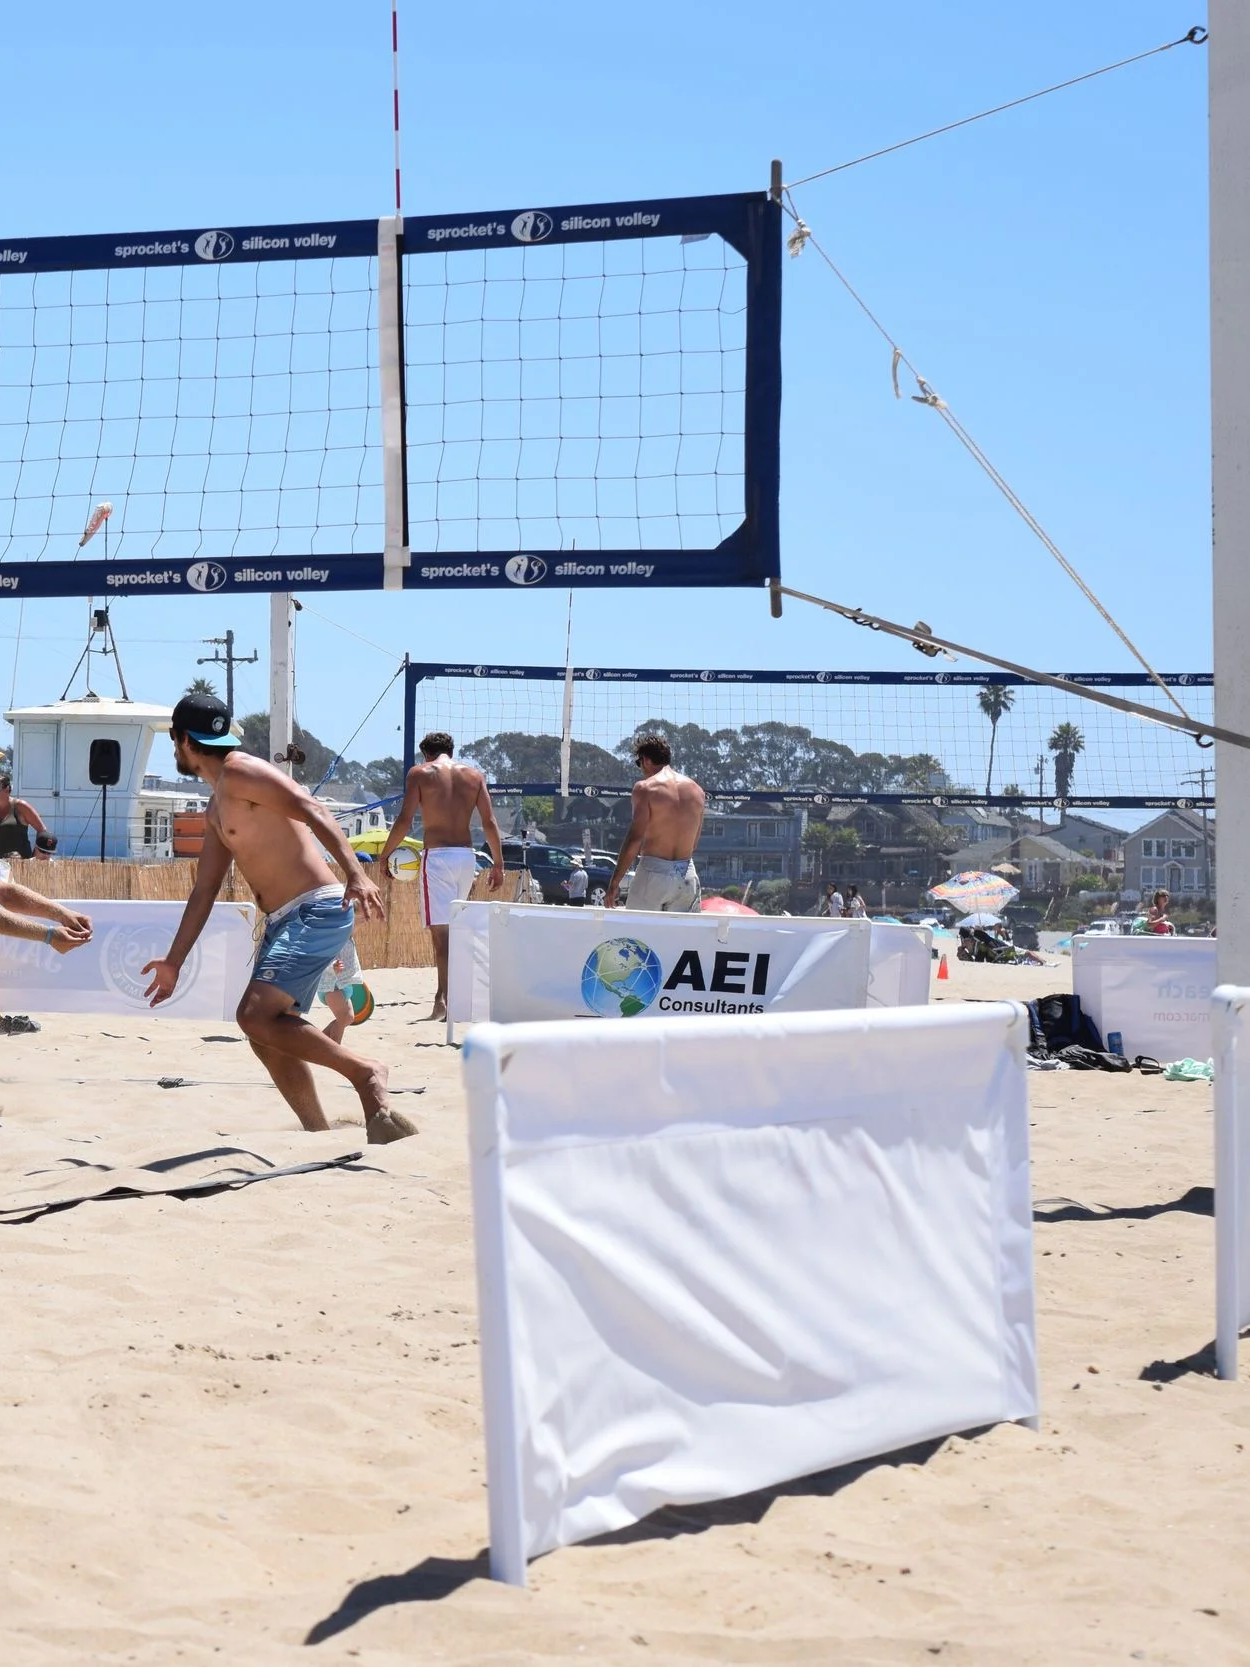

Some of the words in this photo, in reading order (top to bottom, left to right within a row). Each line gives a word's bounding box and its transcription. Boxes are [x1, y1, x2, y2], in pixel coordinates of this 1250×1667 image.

[427, 223, 506, 241] sprocket's
[561, 214, 611, 231] silicon
[615, 212, 661, 230] volley
[114, 241, 189, 258] sprocket's
[242, 234, 291, 250] silicon
[294, 232, 337, 250] volley
[106, 570, 181, 587] sprocket's
[234, 567, 282, 583] silicon
[286, 566, 329, 583] volley
[421, 562, 500, 580] sprocket's
[555, 561, 605, 576] silicon
[609, 561, 655, 578] volley
[662, 950, 770, 996] AEI
[658, 996, 764, 1015] Consultants
